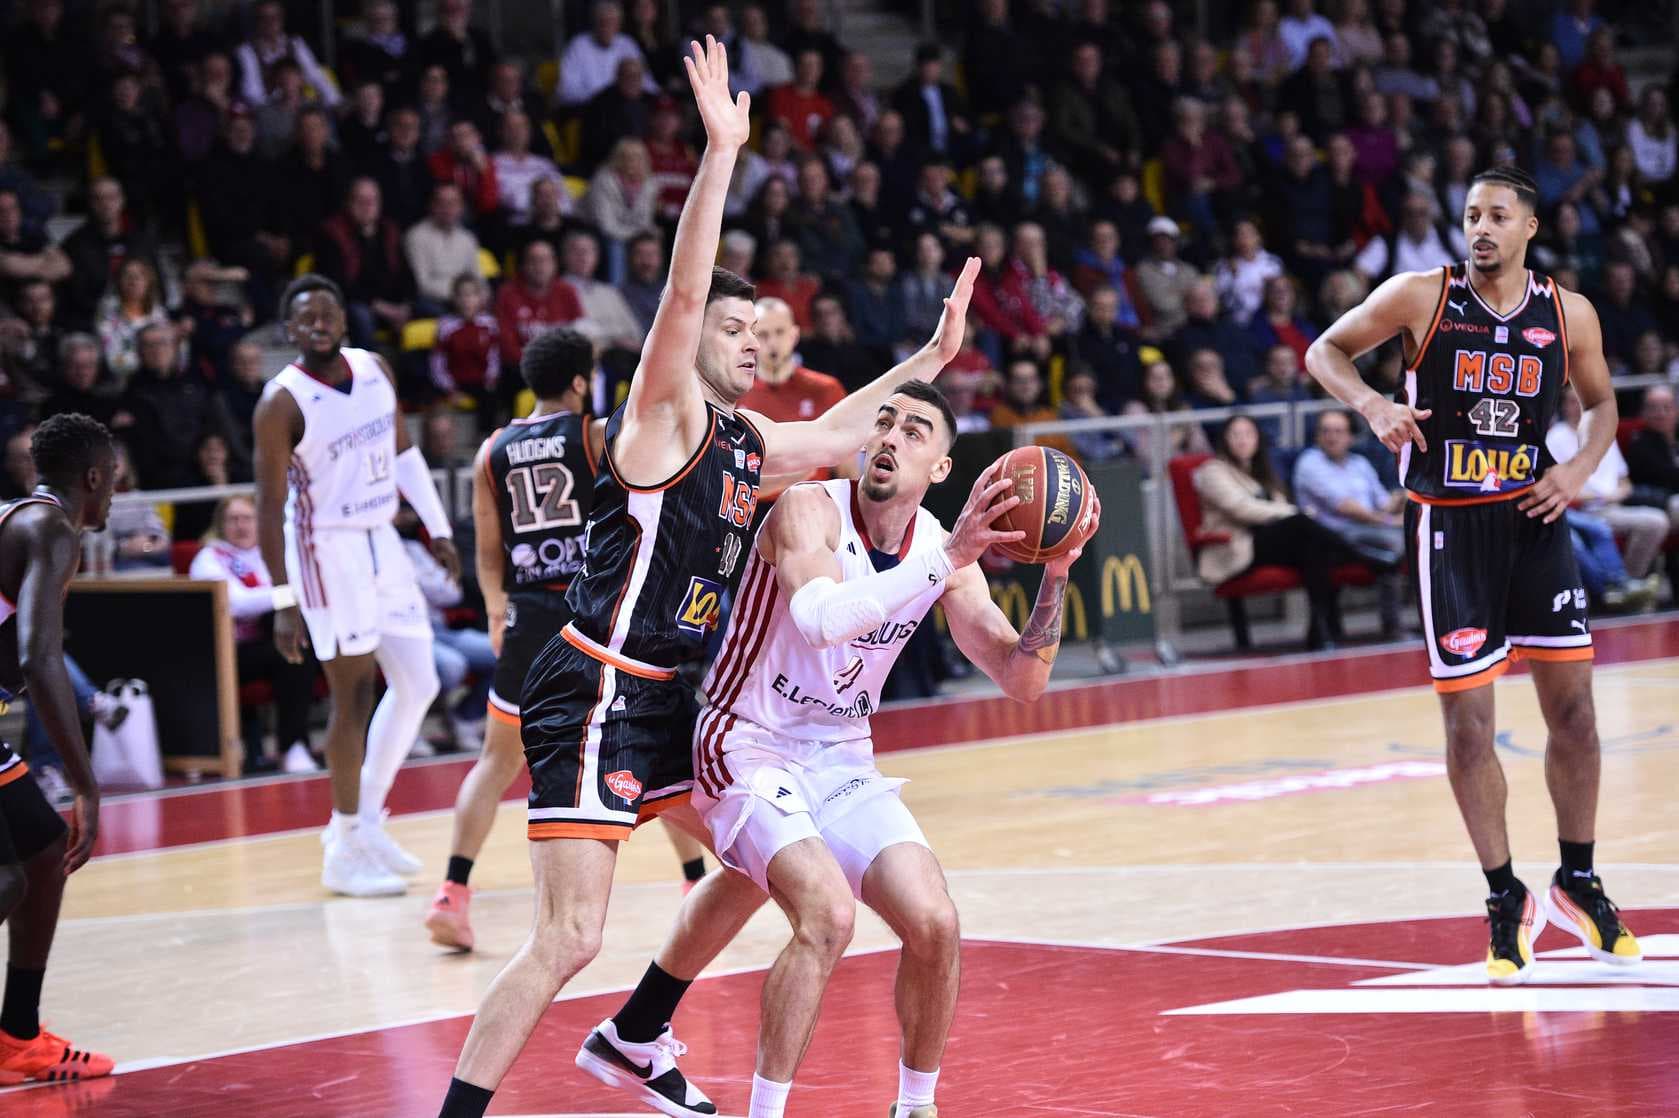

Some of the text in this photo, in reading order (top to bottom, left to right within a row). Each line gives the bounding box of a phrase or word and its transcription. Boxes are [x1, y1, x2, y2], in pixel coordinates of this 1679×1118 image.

[1453, 349, 1543, 397] MSB
[1467, 398, 1520, 437] 42
[506, 435, 566, 466] HUDGINS
[1451, 443, 1531, 481] Loué
[505, 462, 582, 534] 12
